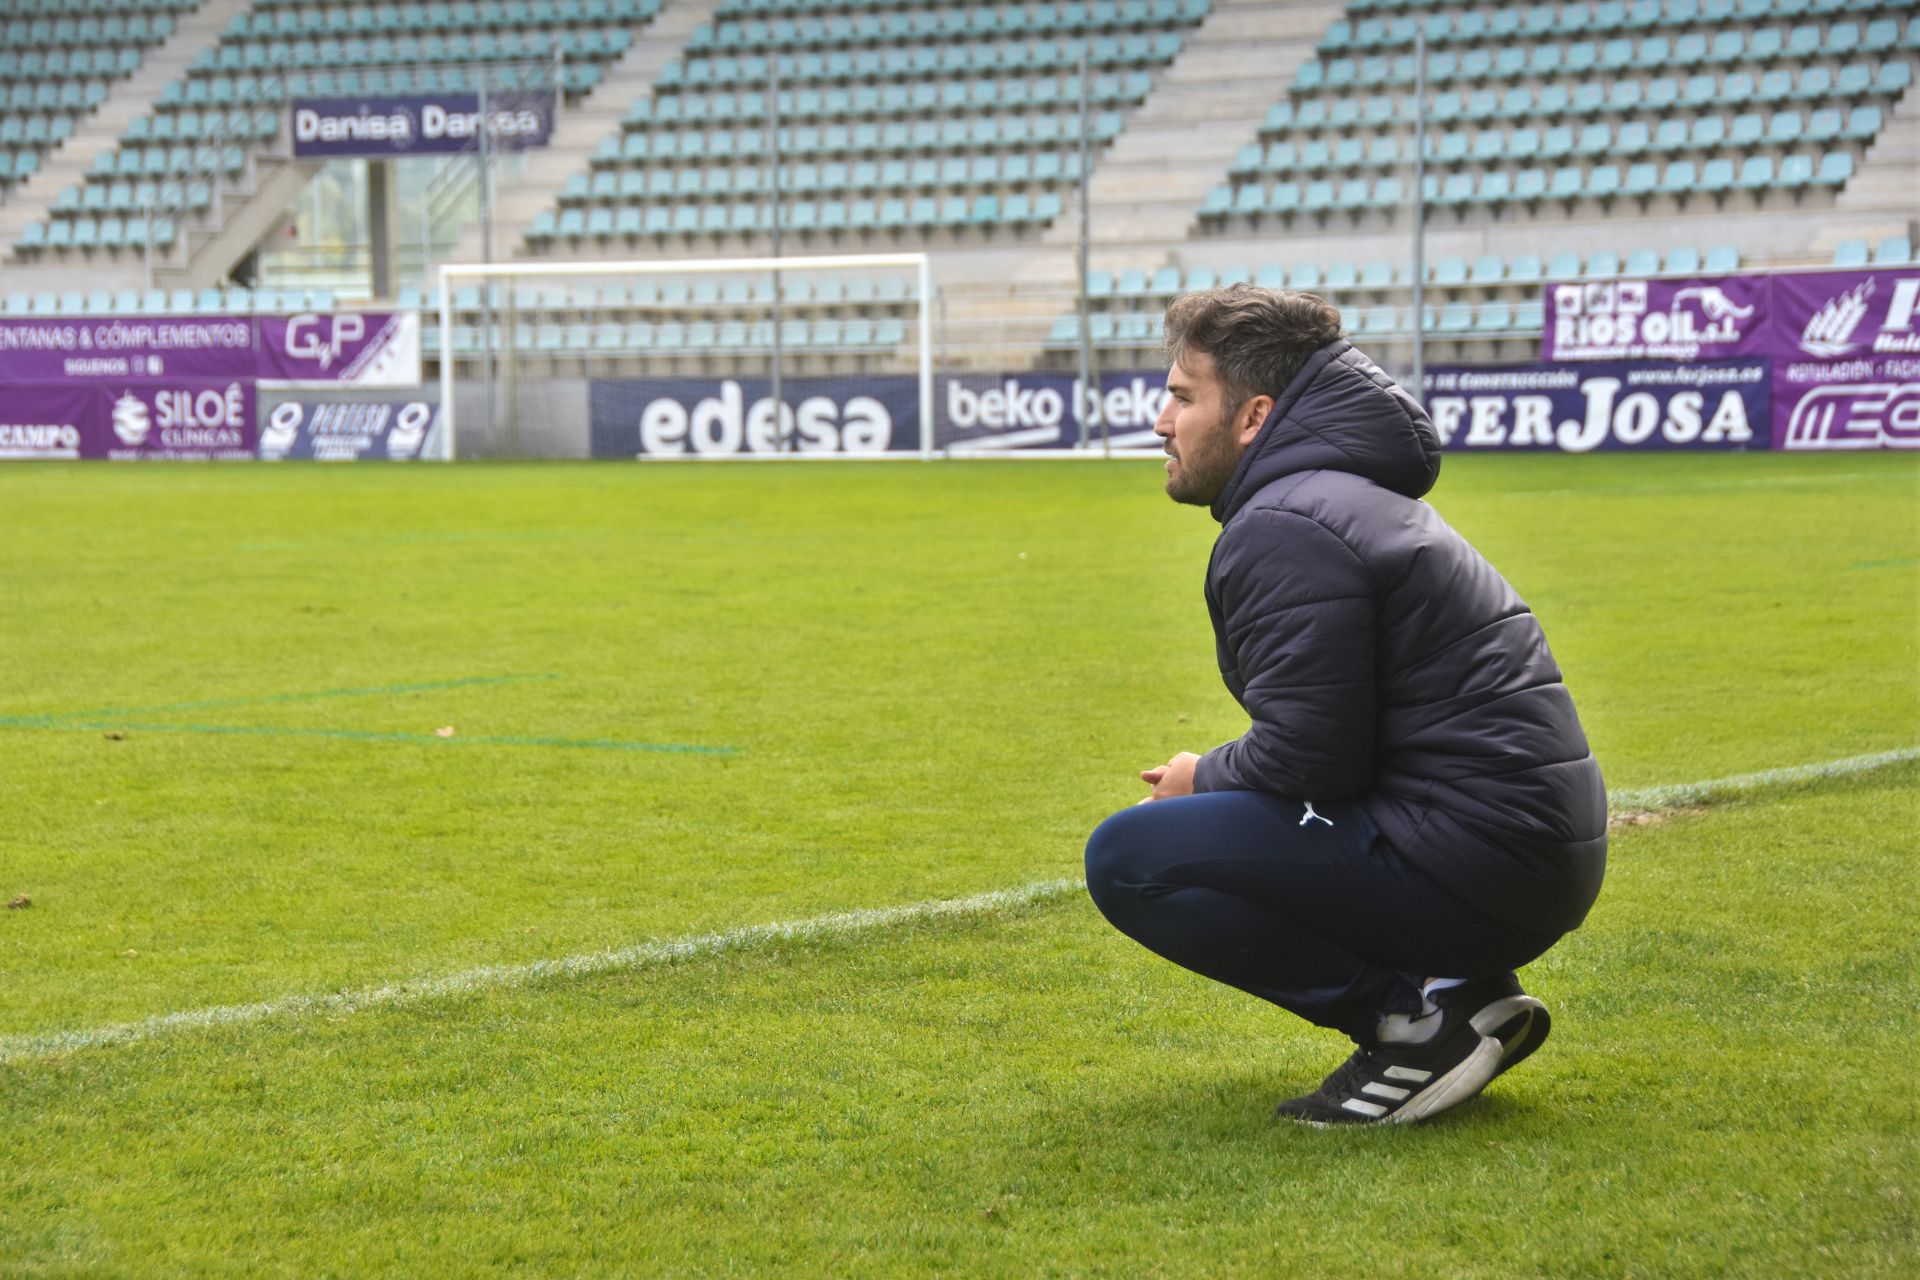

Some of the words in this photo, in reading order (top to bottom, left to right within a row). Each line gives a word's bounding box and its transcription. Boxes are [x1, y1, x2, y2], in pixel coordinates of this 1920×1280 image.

[296, 105, 410, 142] Danisa
[79, 326, 93, 349] &
[155, 381, 245, 427] SILOÉ
[640, 380, 892, 455] edesa
[947, 379, 1063, 428] beko
